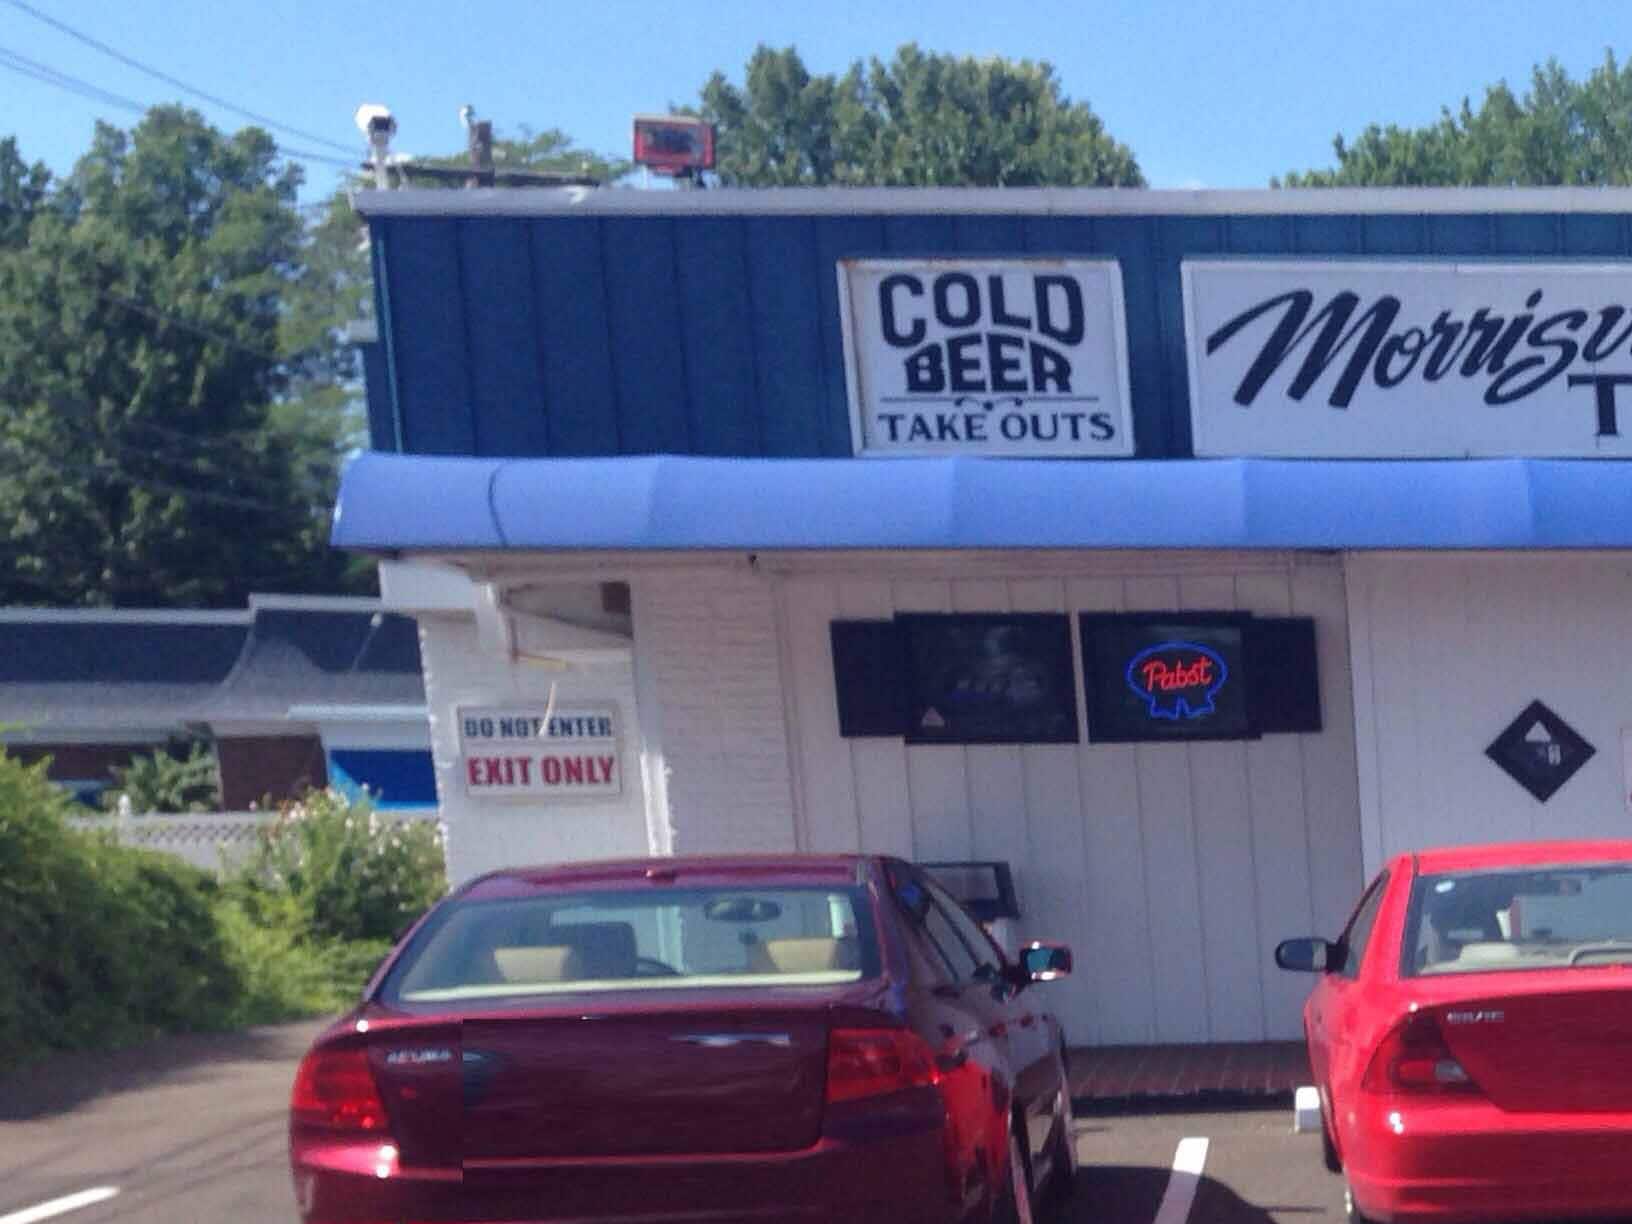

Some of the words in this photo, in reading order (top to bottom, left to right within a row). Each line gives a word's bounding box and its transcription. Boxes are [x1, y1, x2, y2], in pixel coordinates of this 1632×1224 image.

[878, 272, 1085, 348] COLD
[904, 332, 1072, 393] BEER
[877, 412, 989, 442] TAKE
[1000, 412, 1116, 441] OUTS
[1141, 655, 1213, 692] Pabst
[464, 716, 494, 737] DO
[548, 716, 611, 737] ENTER
[467, 756, 533, 786] EXIT
[541, 756, 615, 786] ONLY
